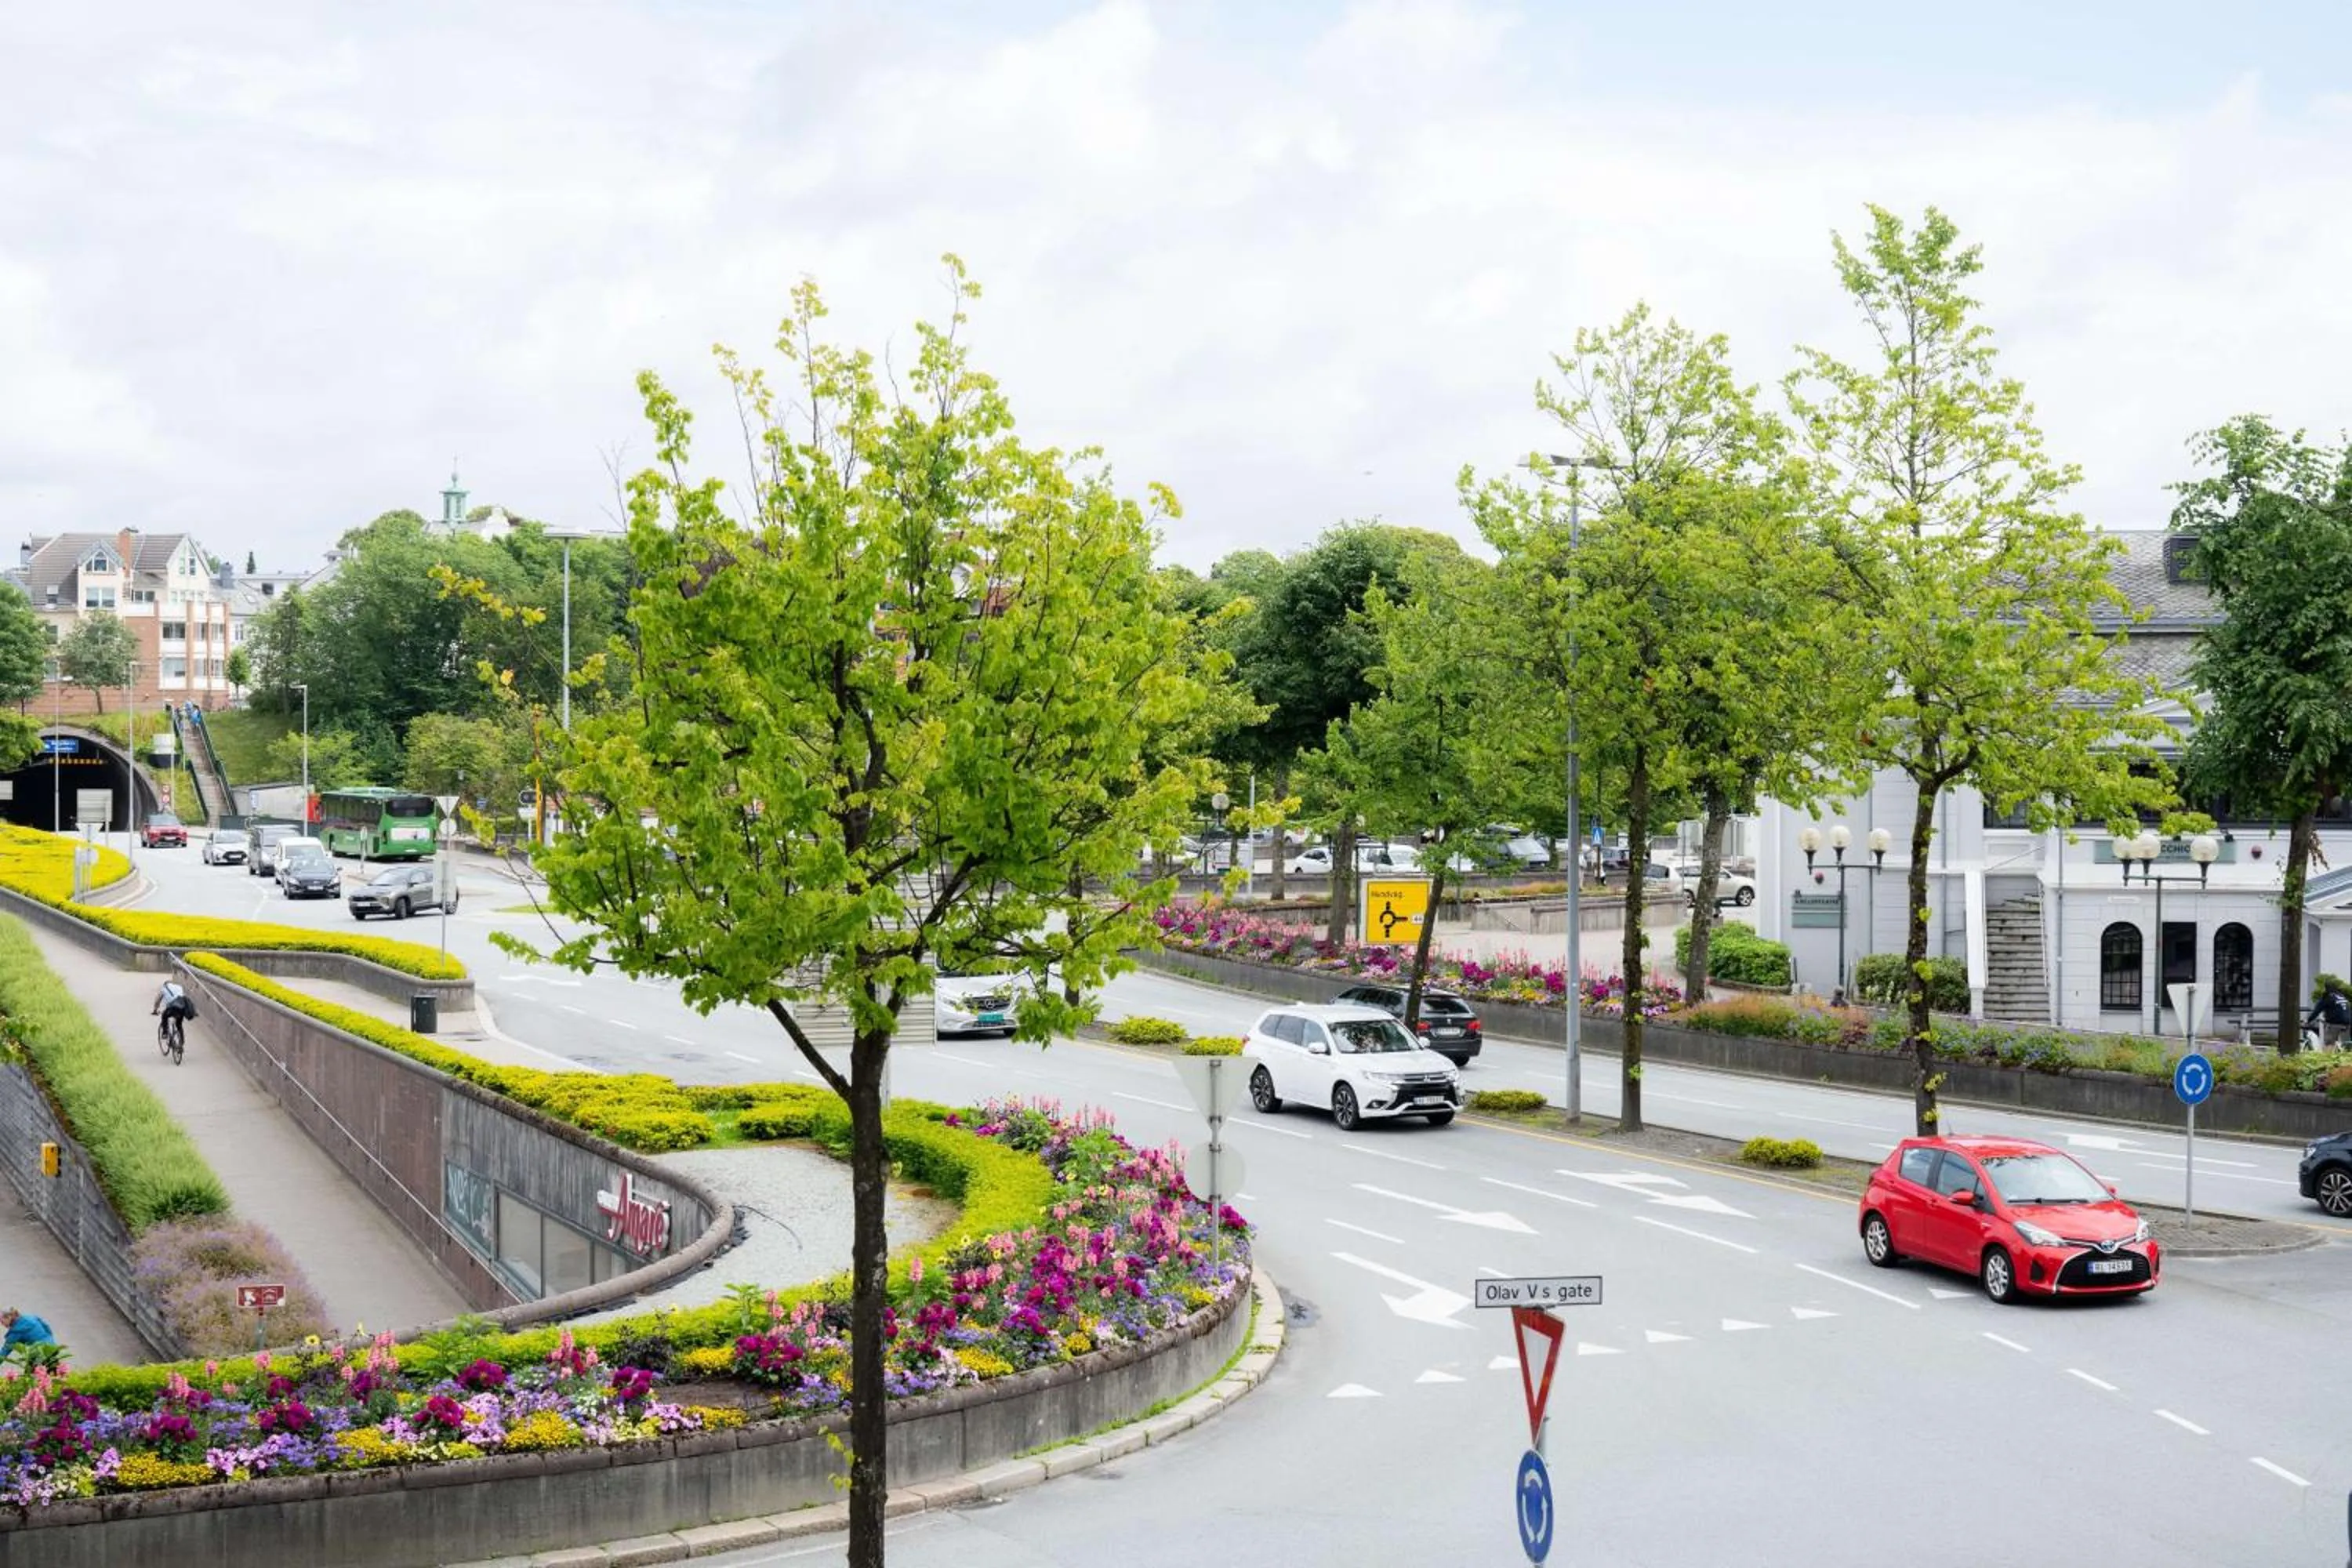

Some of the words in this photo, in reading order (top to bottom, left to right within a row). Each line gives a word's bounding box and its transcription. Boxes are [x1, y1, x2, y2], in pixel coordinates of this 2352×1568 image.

[1486, 1285, 1520, 1300] Olav
[1527, 1284, 1537, 1299] V
[1542, 1287, 1550, 1298] s
[1558, 1283, 1592, 1301] gate
